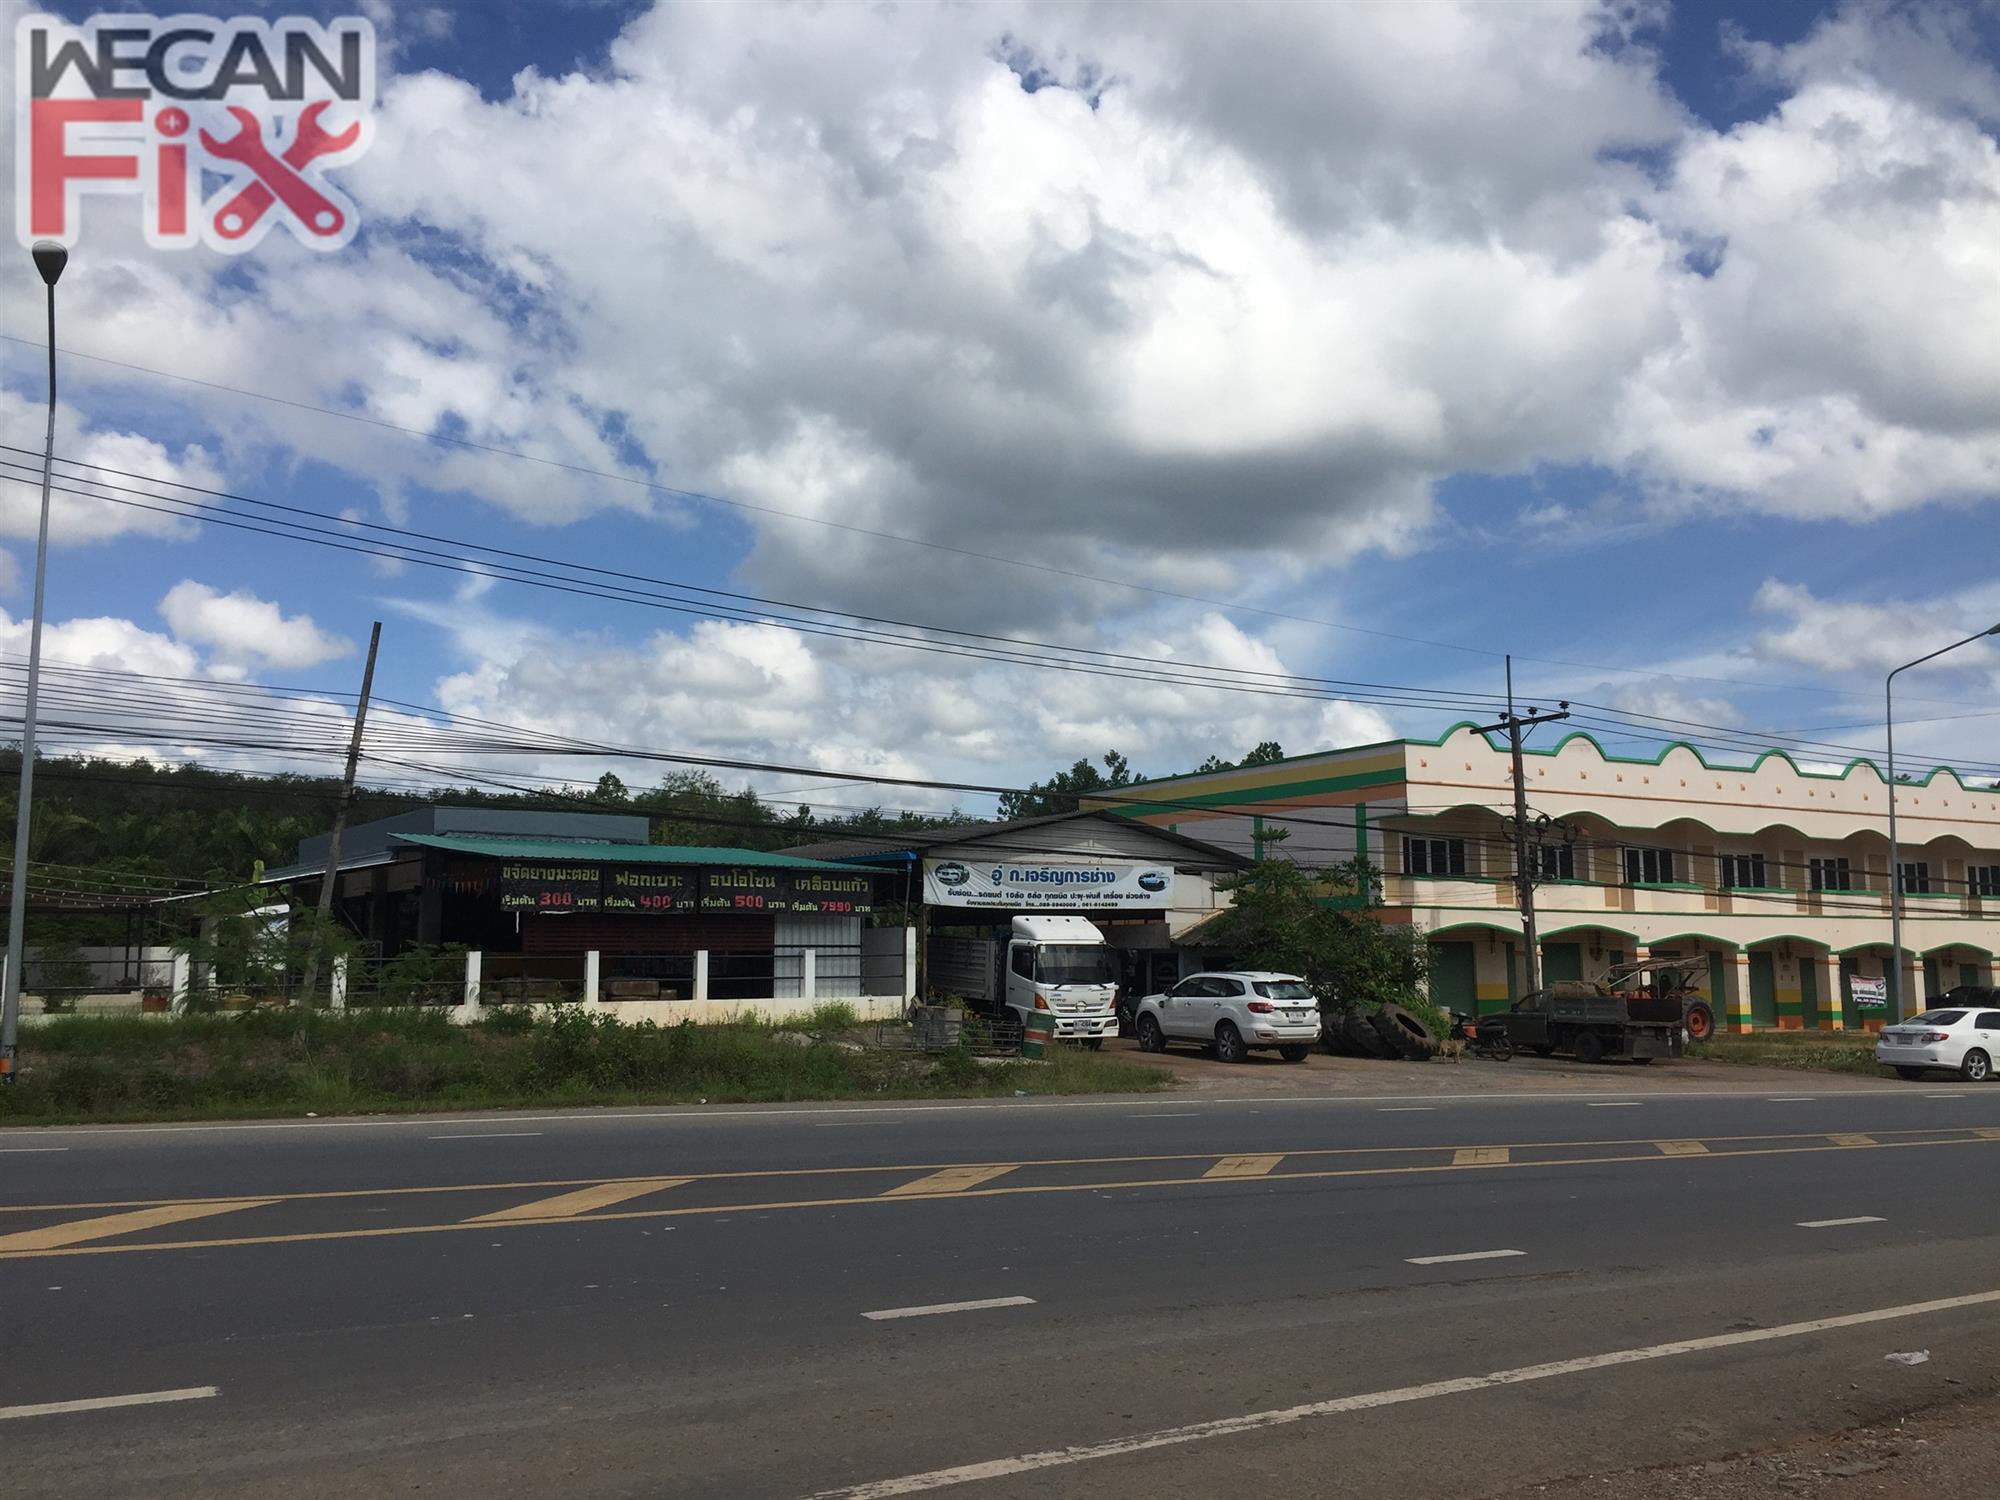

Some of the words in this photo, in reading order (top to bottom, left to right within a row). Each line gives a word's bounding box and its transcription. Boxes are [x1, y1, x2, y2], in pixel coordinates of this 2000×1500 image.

[502, 863, 599, 881] ขจัดยางมะตอย
[616, 871, 684, 887] ฟอกเบาะ
[710, 868, 776, 888] อบโอโซน
[991, 865, 1003, 886] อู่
[1010, 867, 1116, 886] ก.เจริญการช่าง
[795, 875, 869, 892] เคลือบแก้ว
[540, 892, 572, 907] 300
[640, 895, 672, 909] 400
[701, 896, 731, 907] เริ่มต้น
[735, 895, 763, 908] 500
[768, 901, 785, 909] บาท
[792, 899, 818, 911] เริ่มต้น
